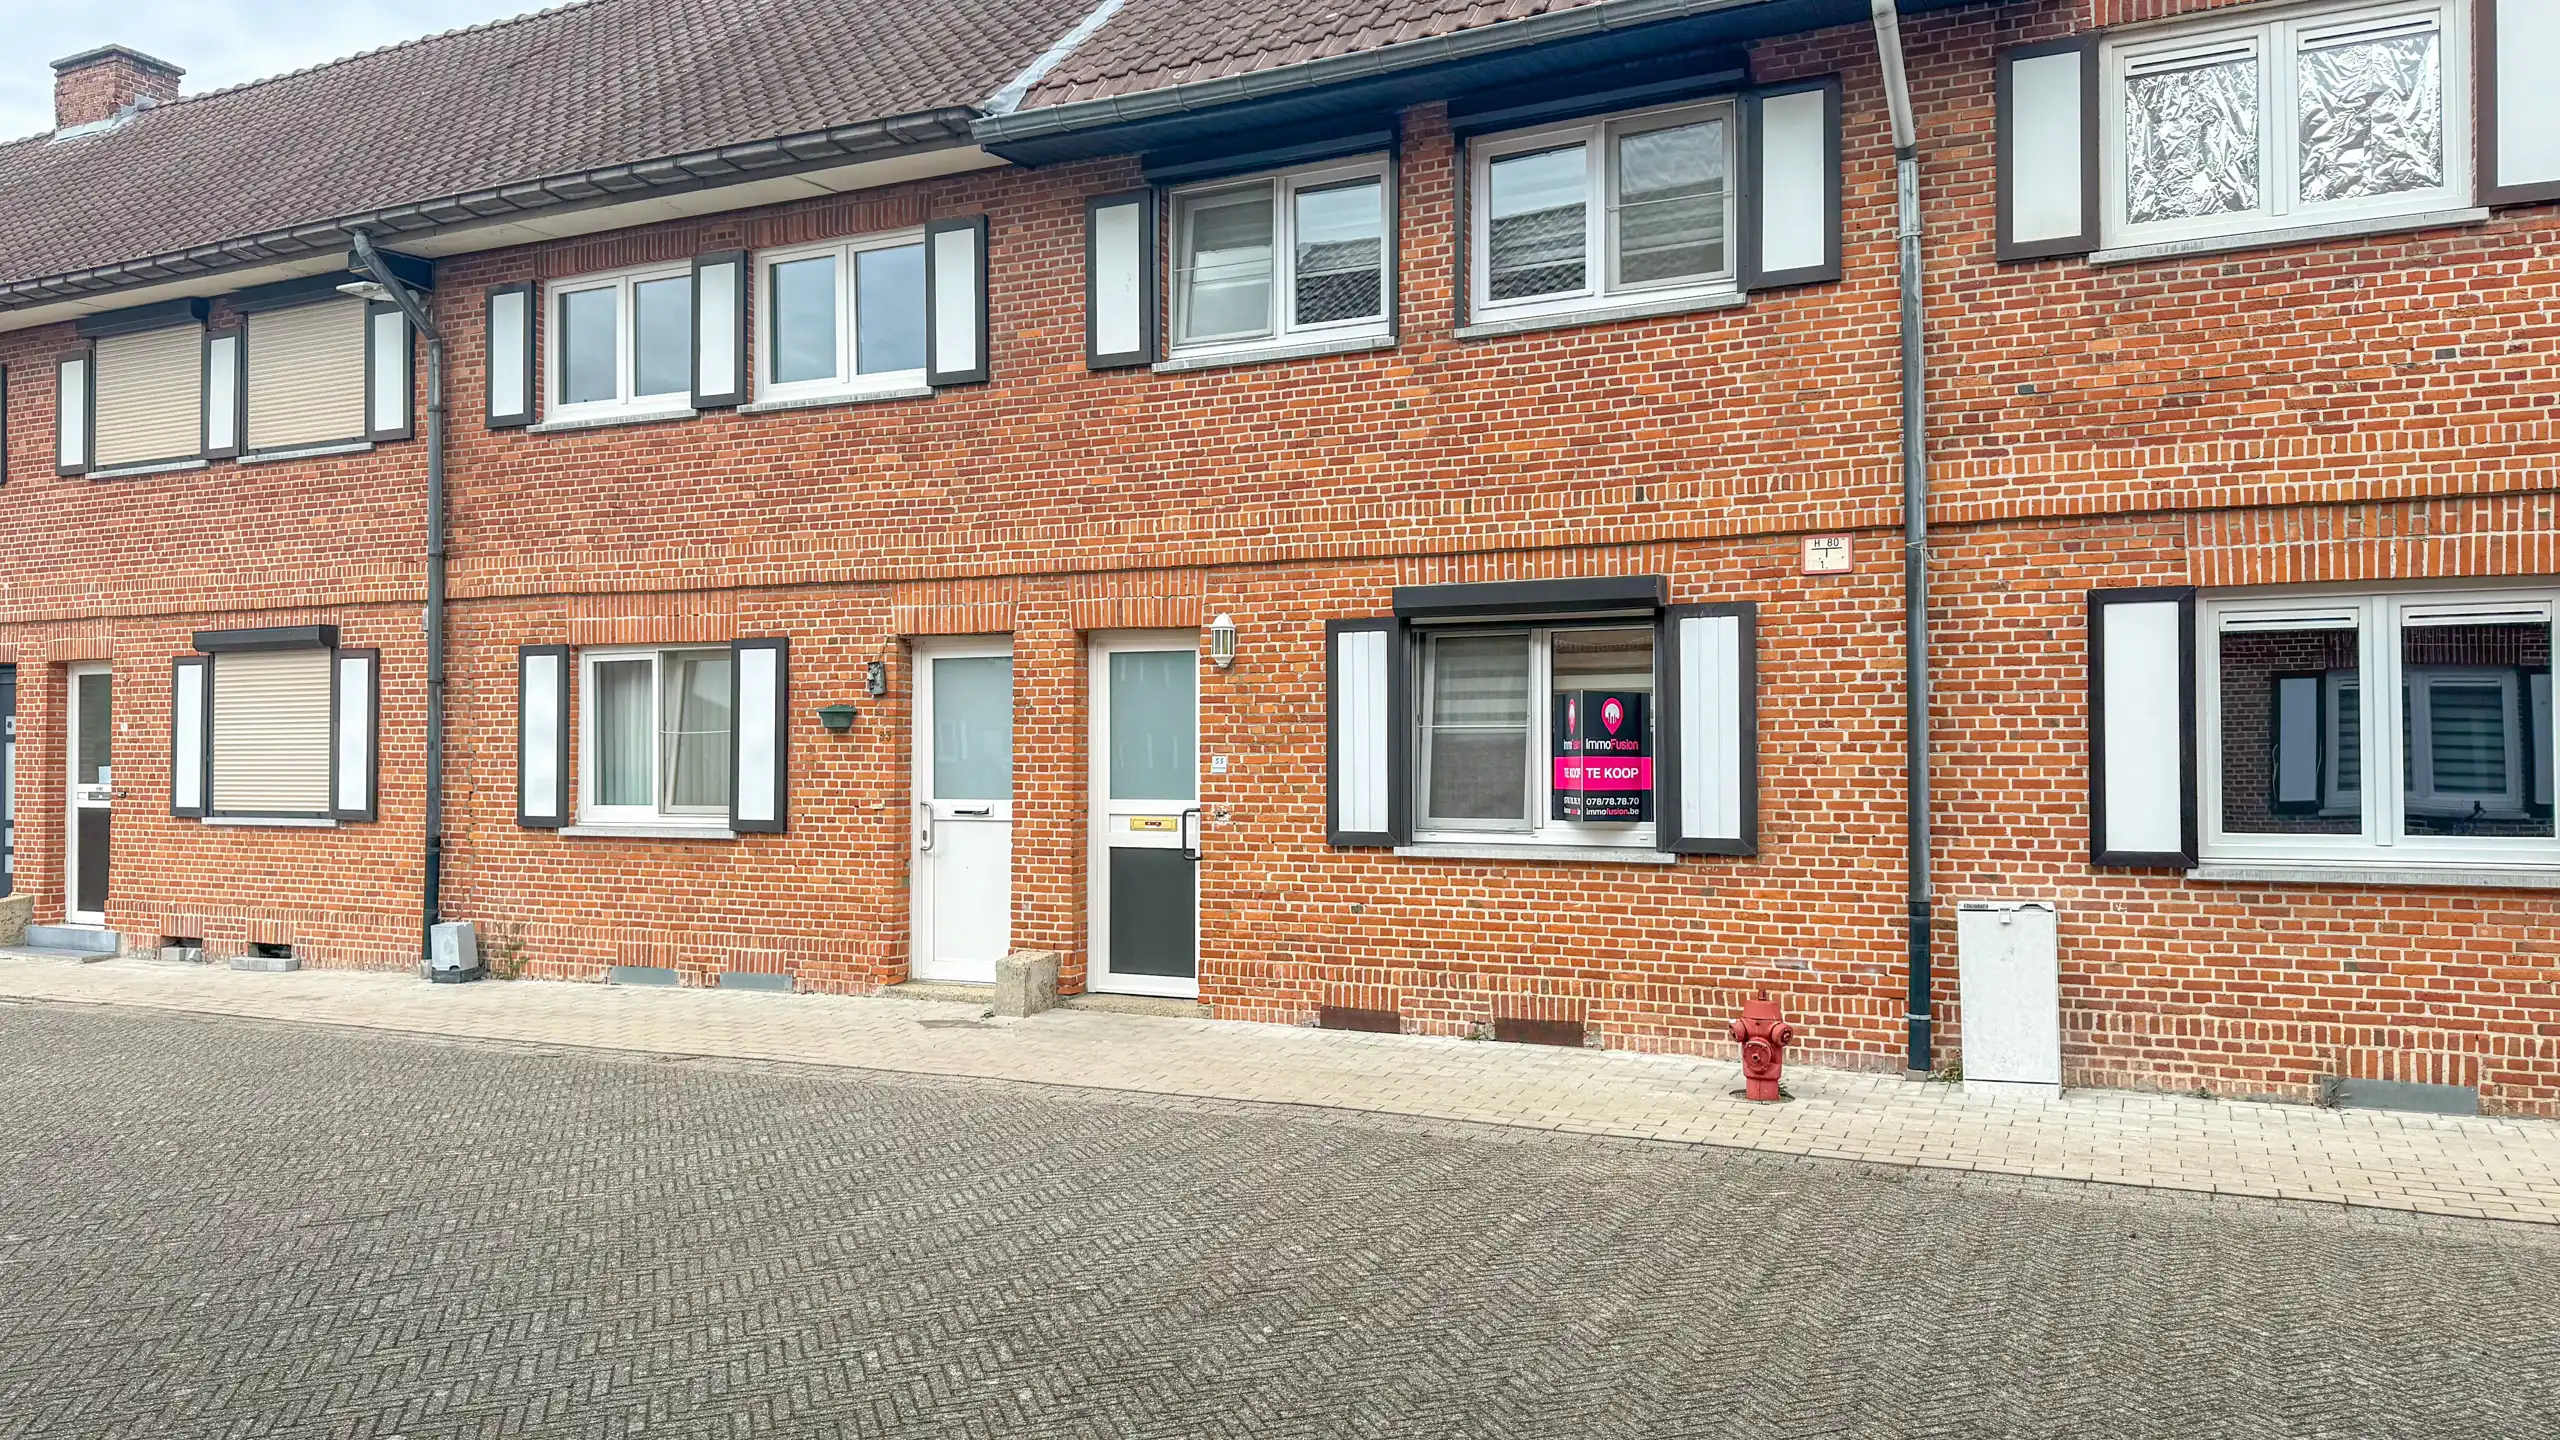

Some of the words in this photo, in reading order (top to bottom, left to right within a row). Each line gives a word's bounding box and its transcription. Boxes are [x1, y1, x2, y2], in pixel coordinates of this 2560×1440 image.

[1814, 539, 1821, 548] H
[1826, 537, 1840, 547] 80
[1585, 738, 1639, 750] ImmoFusion
[1585, 767, 1601, 779] TE
[1604, 767, 1639, 779] KOOP
[1586, 797, 1640, 806] 078/78.78.70
